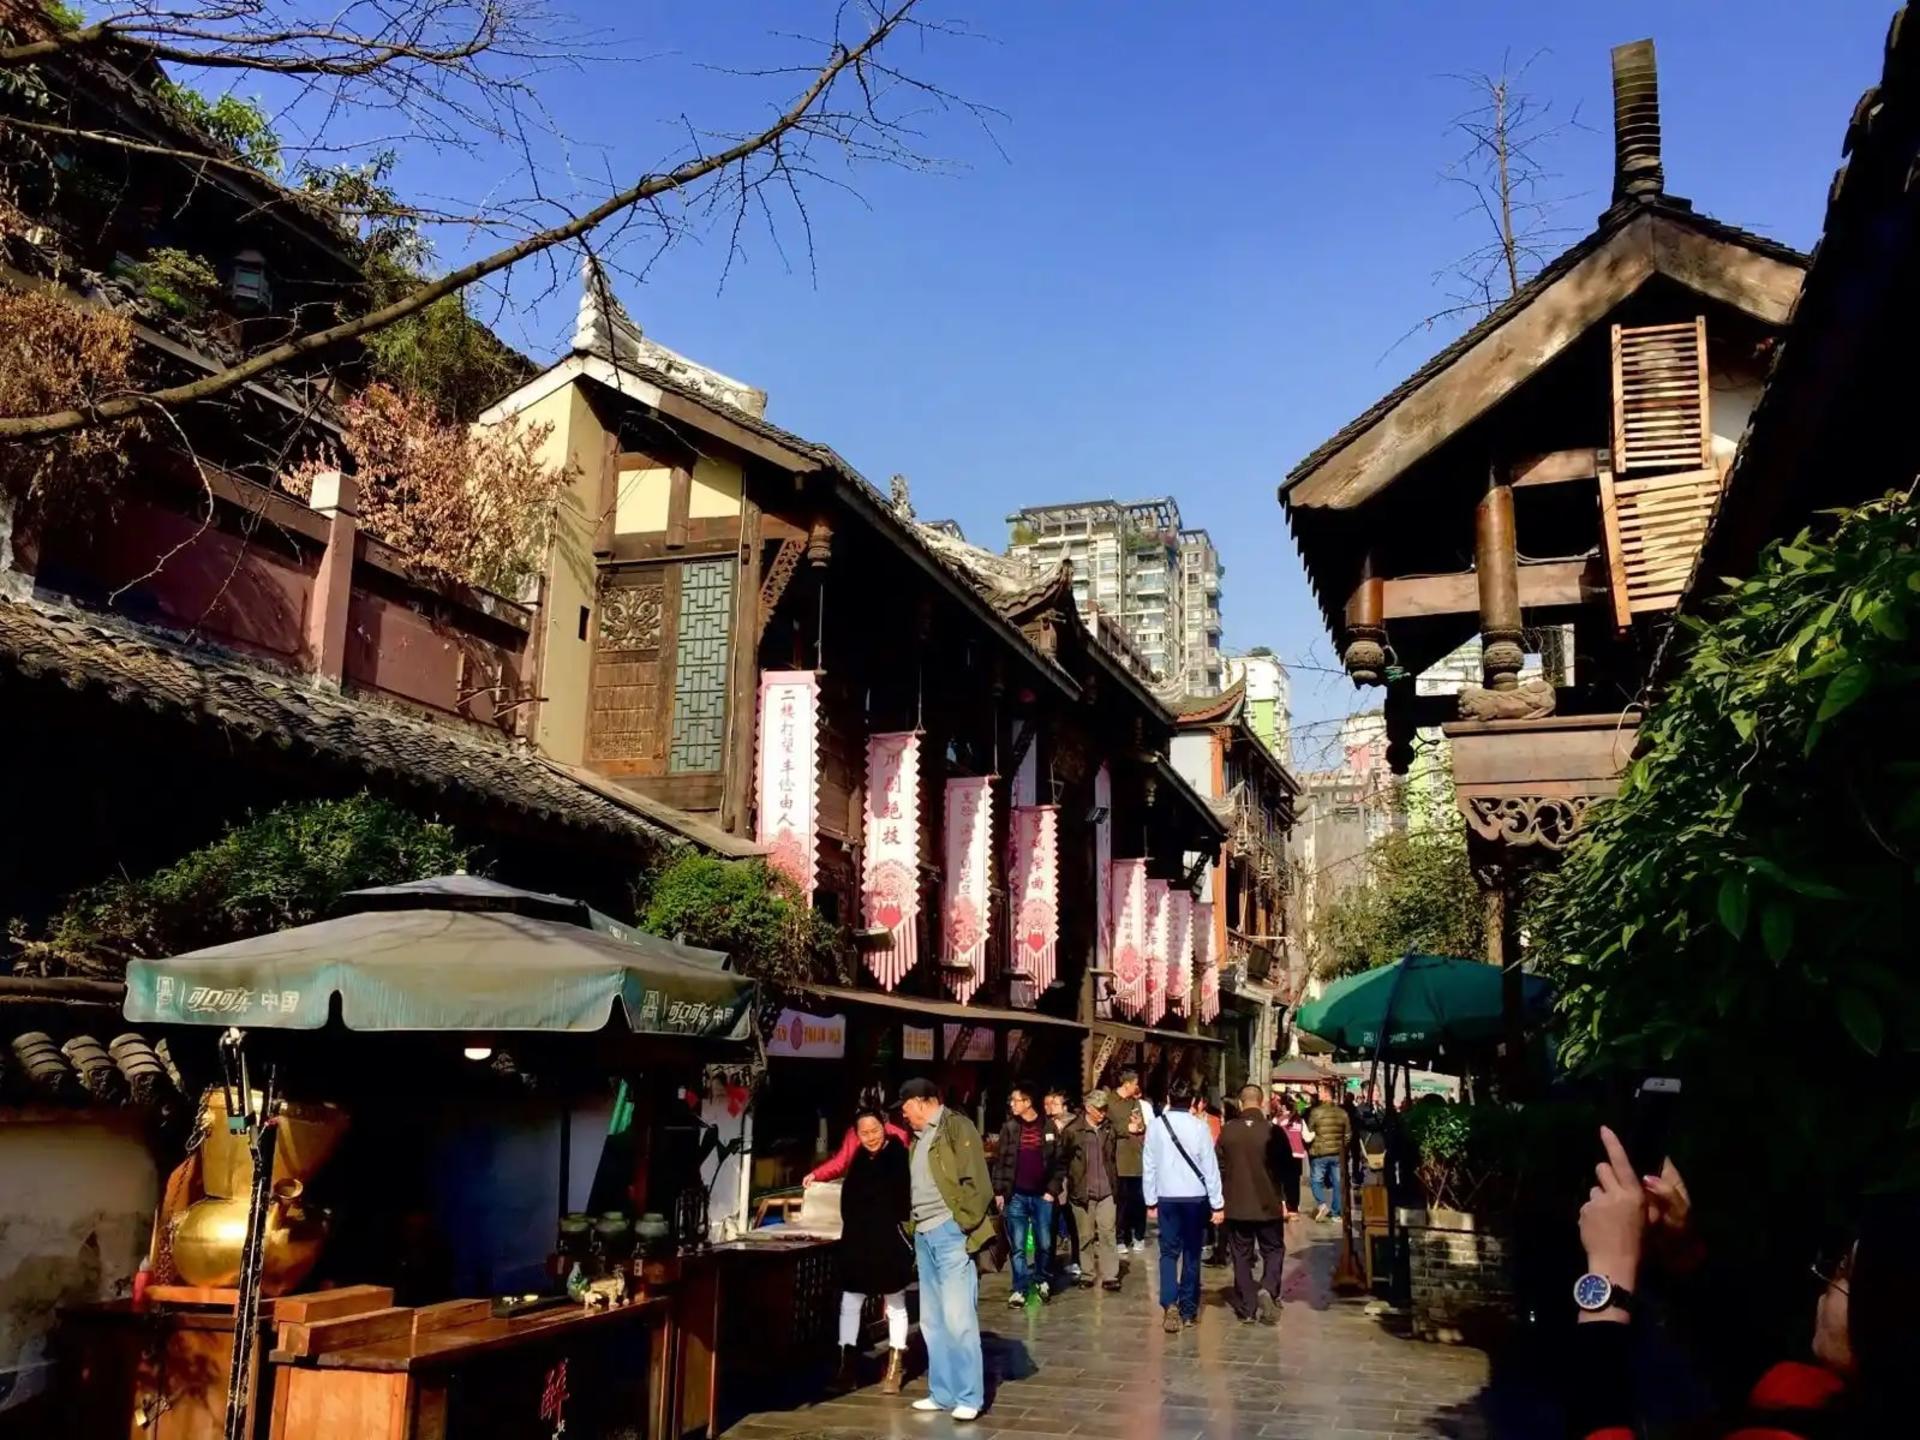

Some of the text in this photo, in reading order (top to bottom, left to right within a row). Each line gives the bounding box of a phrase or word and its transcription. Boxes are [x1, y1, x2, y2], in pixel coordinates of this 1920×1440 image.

[882, 752, 902, 845] 川剧绝技
[187, 987, 256, 1013] 可口可乐
[261, 989, 300, 1013] 中国
